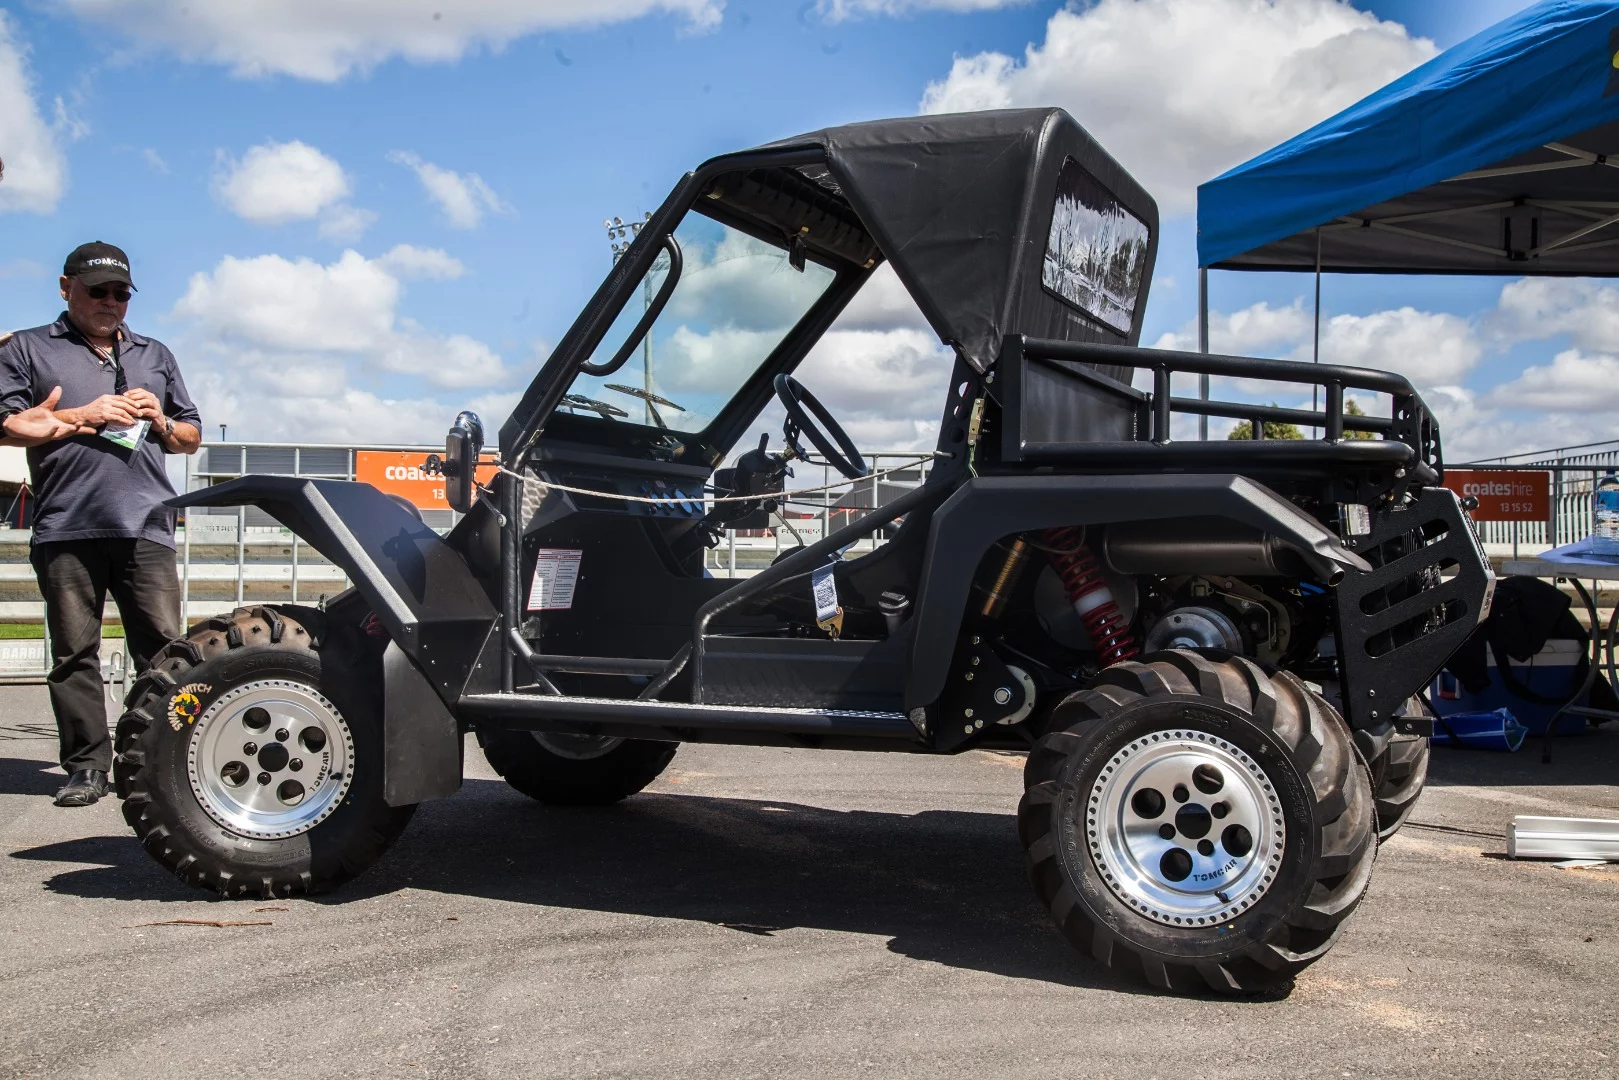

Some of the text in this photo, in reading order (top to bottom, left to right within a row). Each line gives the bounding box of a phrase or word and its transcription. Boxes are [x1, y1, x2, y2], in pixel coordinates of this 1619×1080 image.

[87, 257, 129, 271] TOMCAR
[432, 488, 445, 499] 13
[1499, 502, 1533, 512] 13 15 52
[167, 682, 213, 732] SWAMP WITCH
[308, 751, 329, 792] TOMCAR
[1192, 858, 1239, 883] TOMCAR
